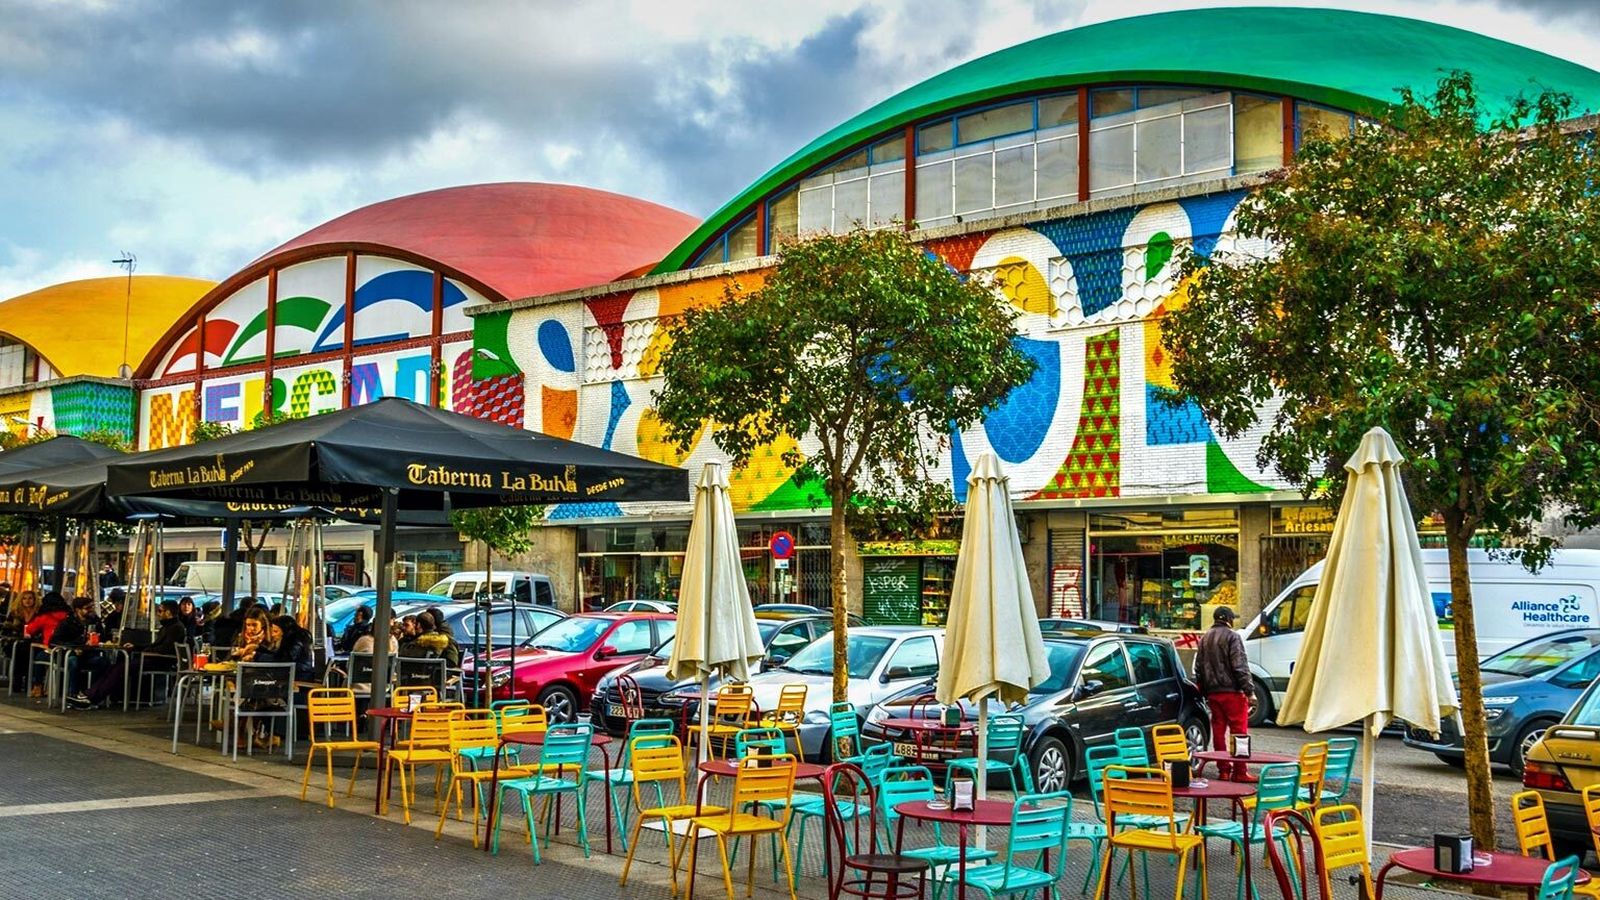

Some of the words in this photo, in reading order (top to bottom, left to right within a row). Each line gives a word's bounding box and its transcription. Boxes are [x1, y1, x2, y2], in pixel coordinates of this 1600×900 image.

[150, 470, 185, 488] Taberna
[187, 467, 200, 484] La
[407, 463, 492, 488] Taberna
[501, 472, 526, 492] La
[586, 483, 608, 496] DESDE
[609, 477, 625, 489] 1970
[1511, 600, 1559, 611] Alliance
[1523, 612, 1590, 623] Healthcare
